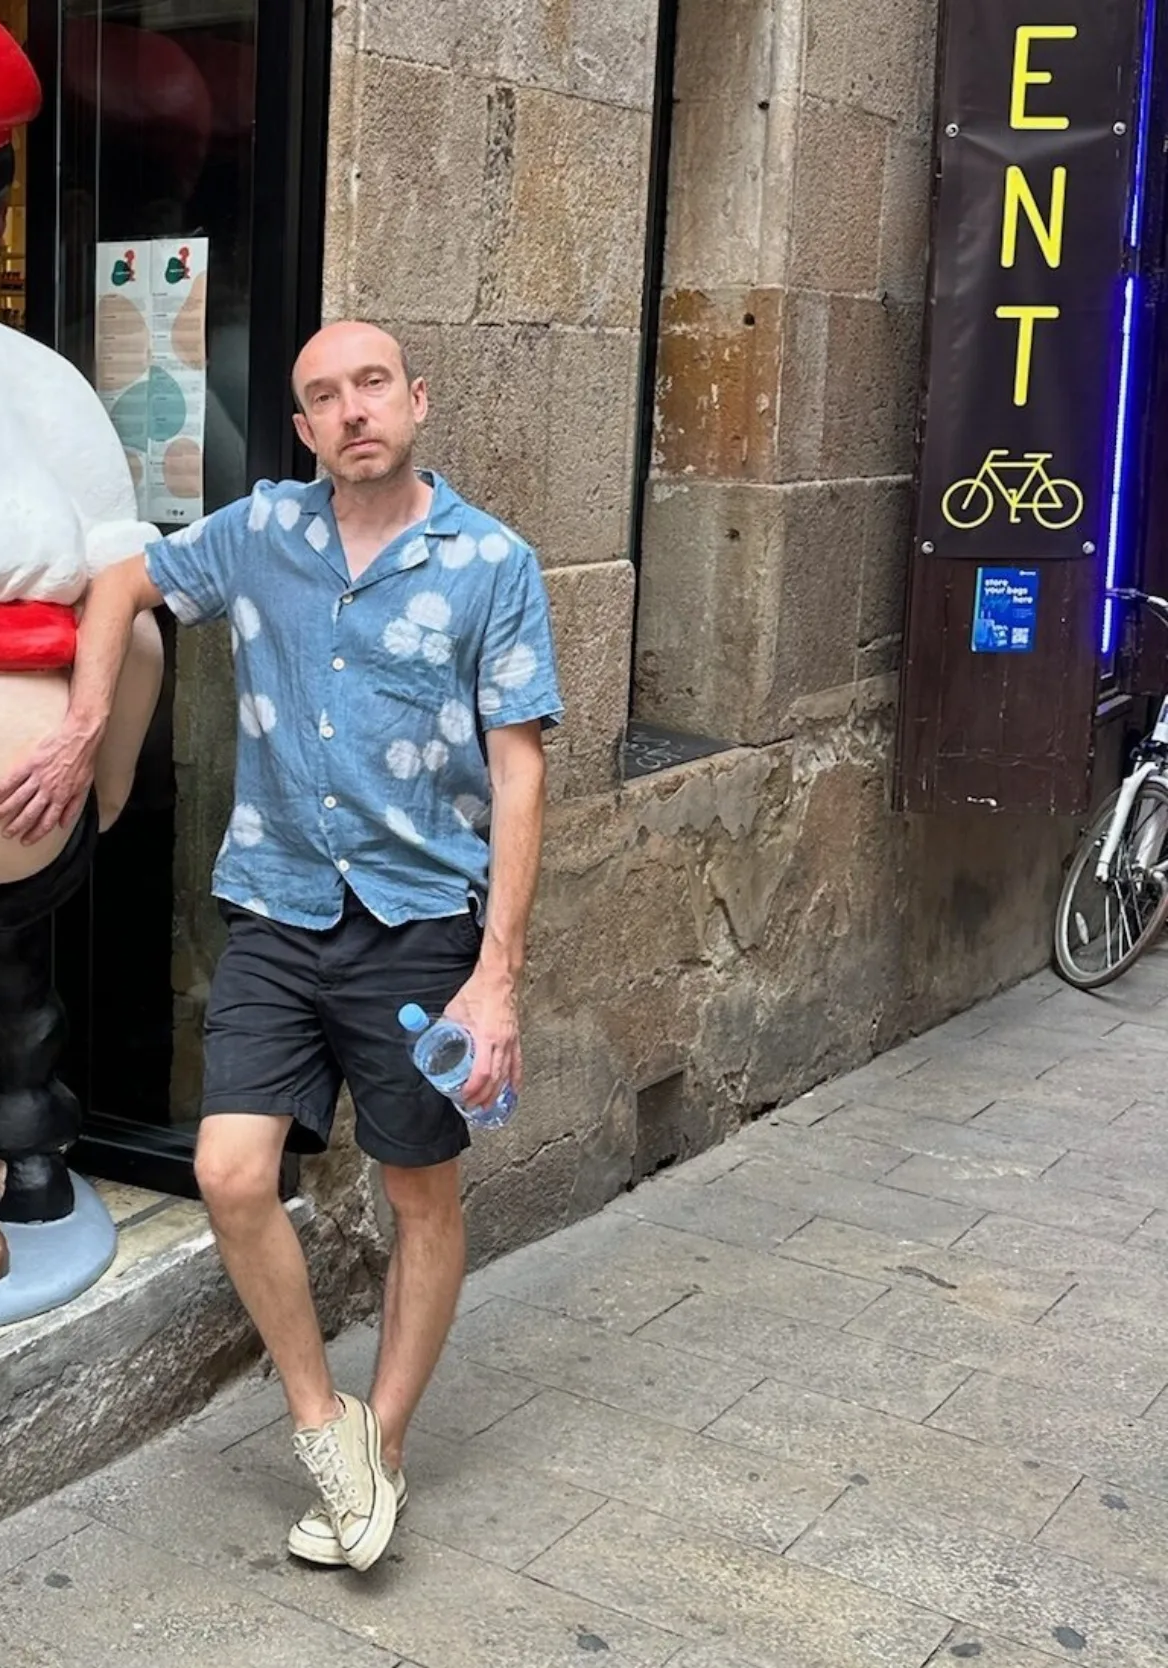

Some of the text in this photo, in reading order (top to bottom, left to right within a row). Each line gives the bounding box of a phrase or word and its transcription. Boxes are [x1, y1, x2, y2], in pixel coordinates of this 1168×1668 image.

[995, 25, 1077, 406] ENT
[985, 579, 1008, 587] store
[984, 586, 1028, 596] your bags
[1012, 596, 1033, 604] here
